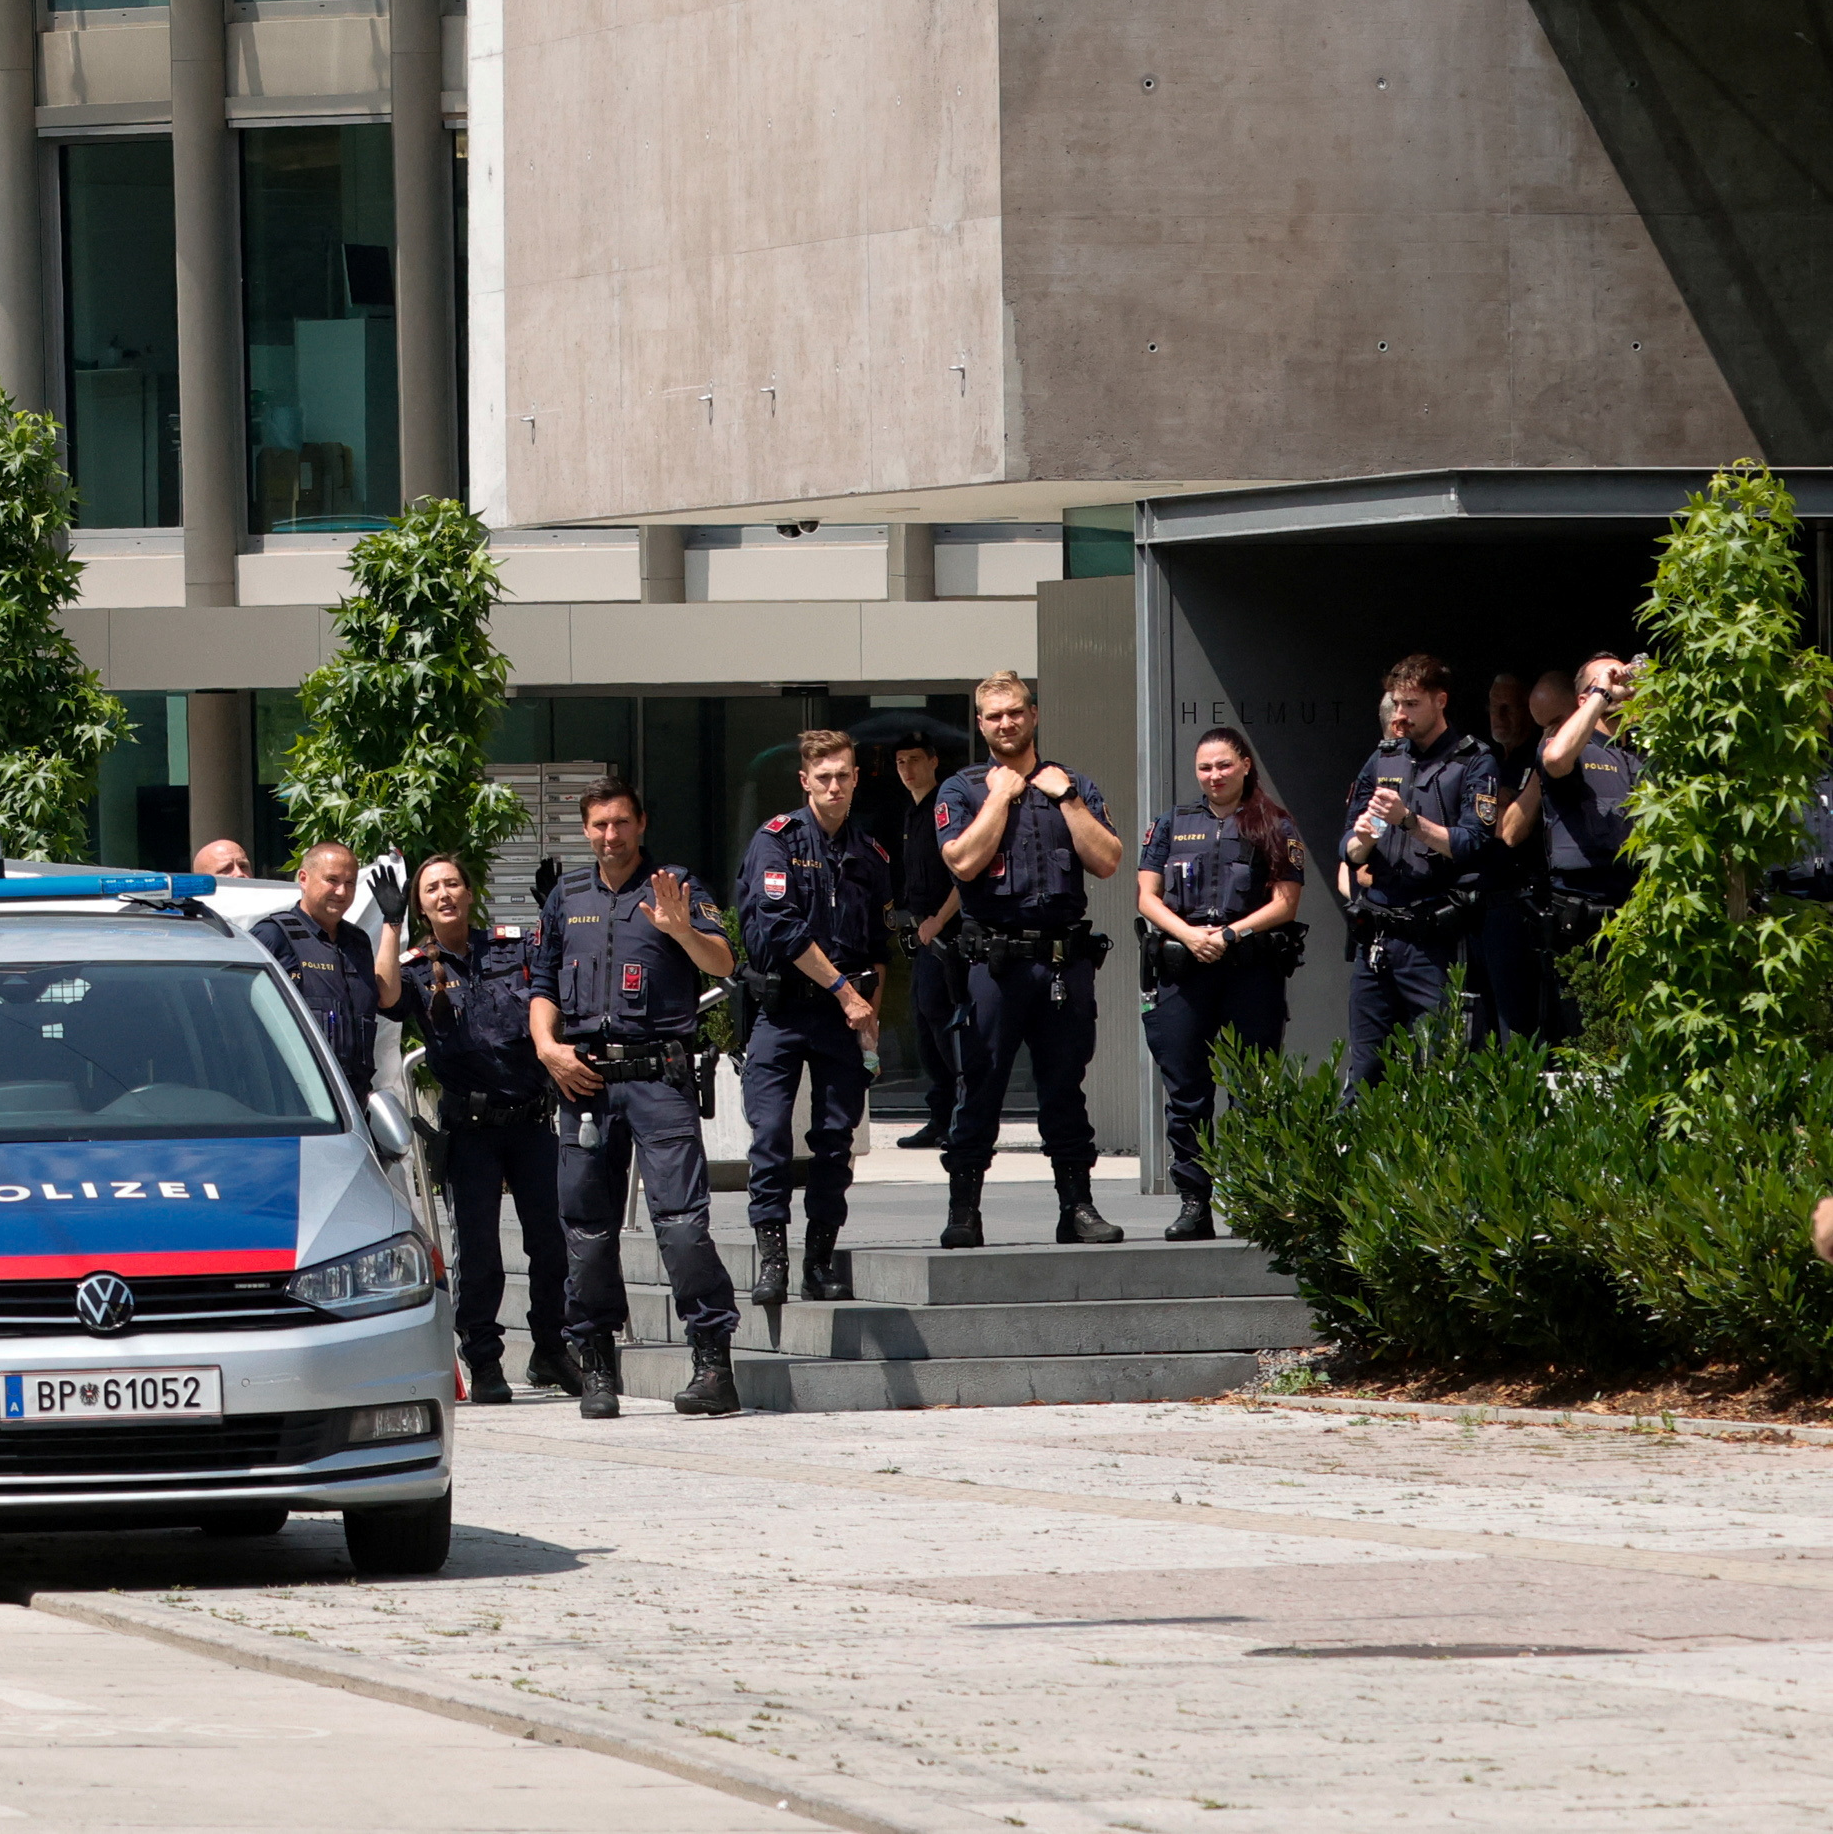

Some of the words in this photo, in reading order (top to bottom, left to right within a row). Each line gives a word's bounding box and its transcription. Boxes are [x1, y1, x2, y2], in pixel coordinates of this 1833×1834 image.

[1182, 701, 1344, 725] HELMUT
[1174, 833, 1206, 842] POLIZEI
[568, 915, 600, 925] POLIZEI
[302, 961, 334, 971] POLIZEI
[37, 1380, 76, 1412] BP
[103, 1376, 201, 1410] 61052
